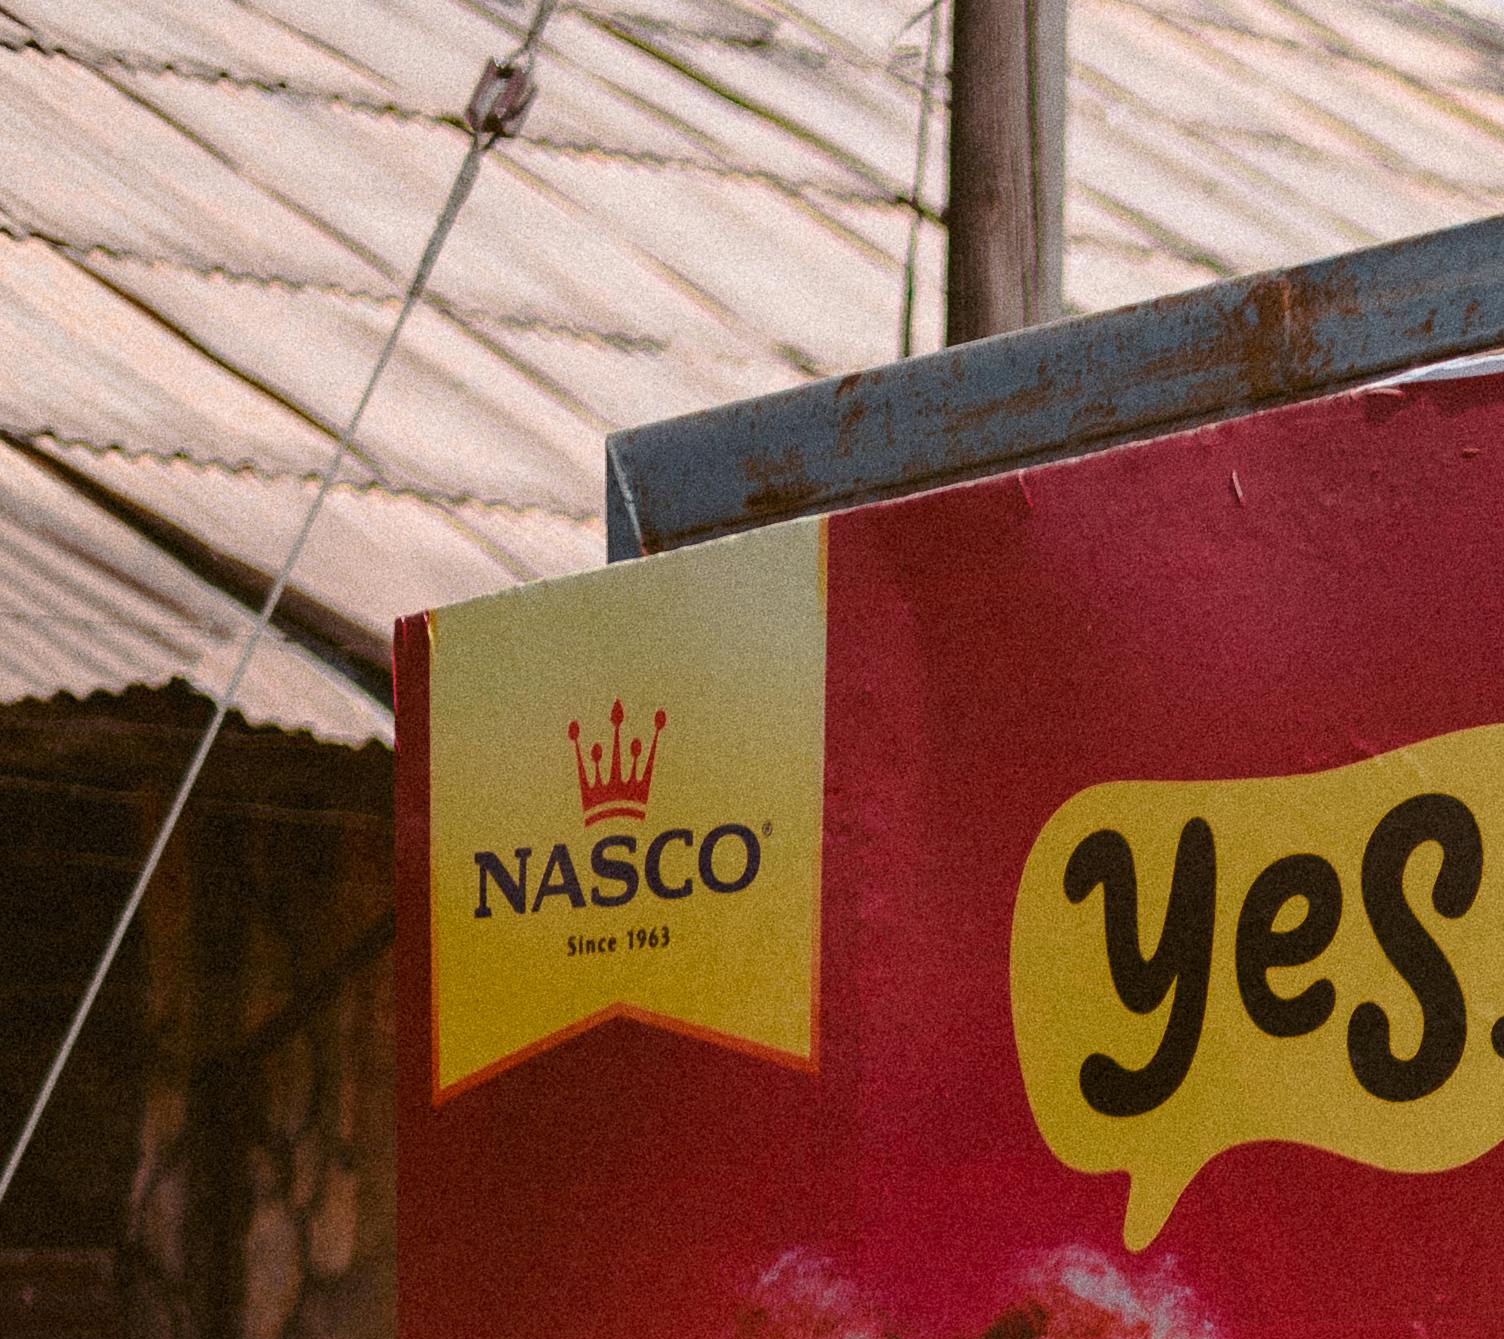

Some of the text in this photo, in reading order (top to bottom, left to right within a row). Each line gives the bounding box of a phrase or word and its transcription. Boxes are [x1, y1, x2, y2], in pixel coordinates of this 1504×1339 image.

[474, 823, 761, 918] NASCO
[567, 927, 671, 957] Since 1963
